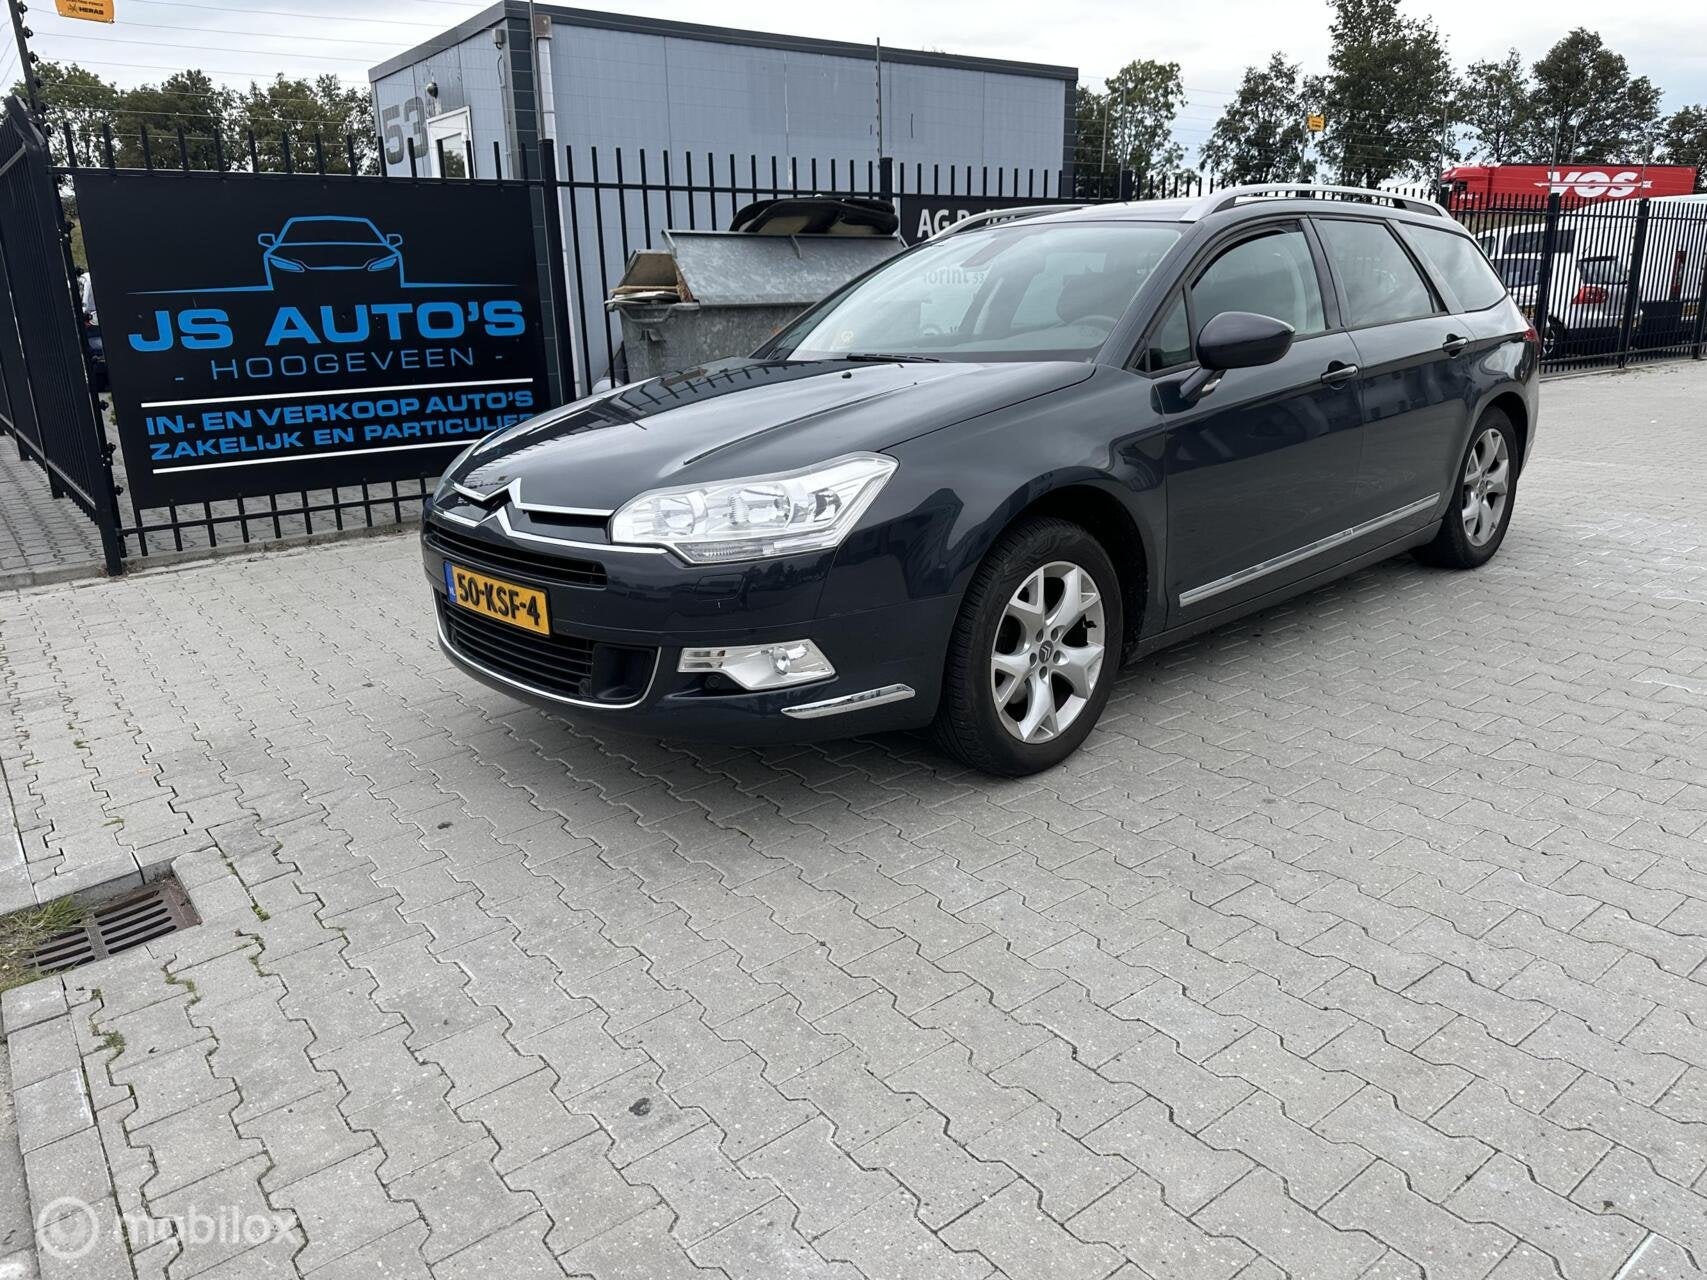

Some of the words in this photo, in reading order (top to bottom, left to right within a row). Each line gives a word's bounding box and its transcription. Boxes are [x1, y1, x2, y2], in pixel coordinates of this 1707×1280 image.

[79, 6, 104, 15] HERAS
[382, 97, 428, 165] 53
[1547, 171, 1638, 198] VOS
[128, 309, 233, 351] JS
[265, 300, 526, 346] AUTO'S
[211, 347, 474, 380] HOOGEVEEN
[146, 415, 195, 436] IN-
[202, 410, 253, 431] EN
[257, 398, 420, 425] VERKOOP
[425, 390, 534, 413] AUTO'S
[150, 432, 304, 460] ZAKELIJK
[313, 428, 354, 446] EN
[456, 572, 541, 627] 50-KSF-4
